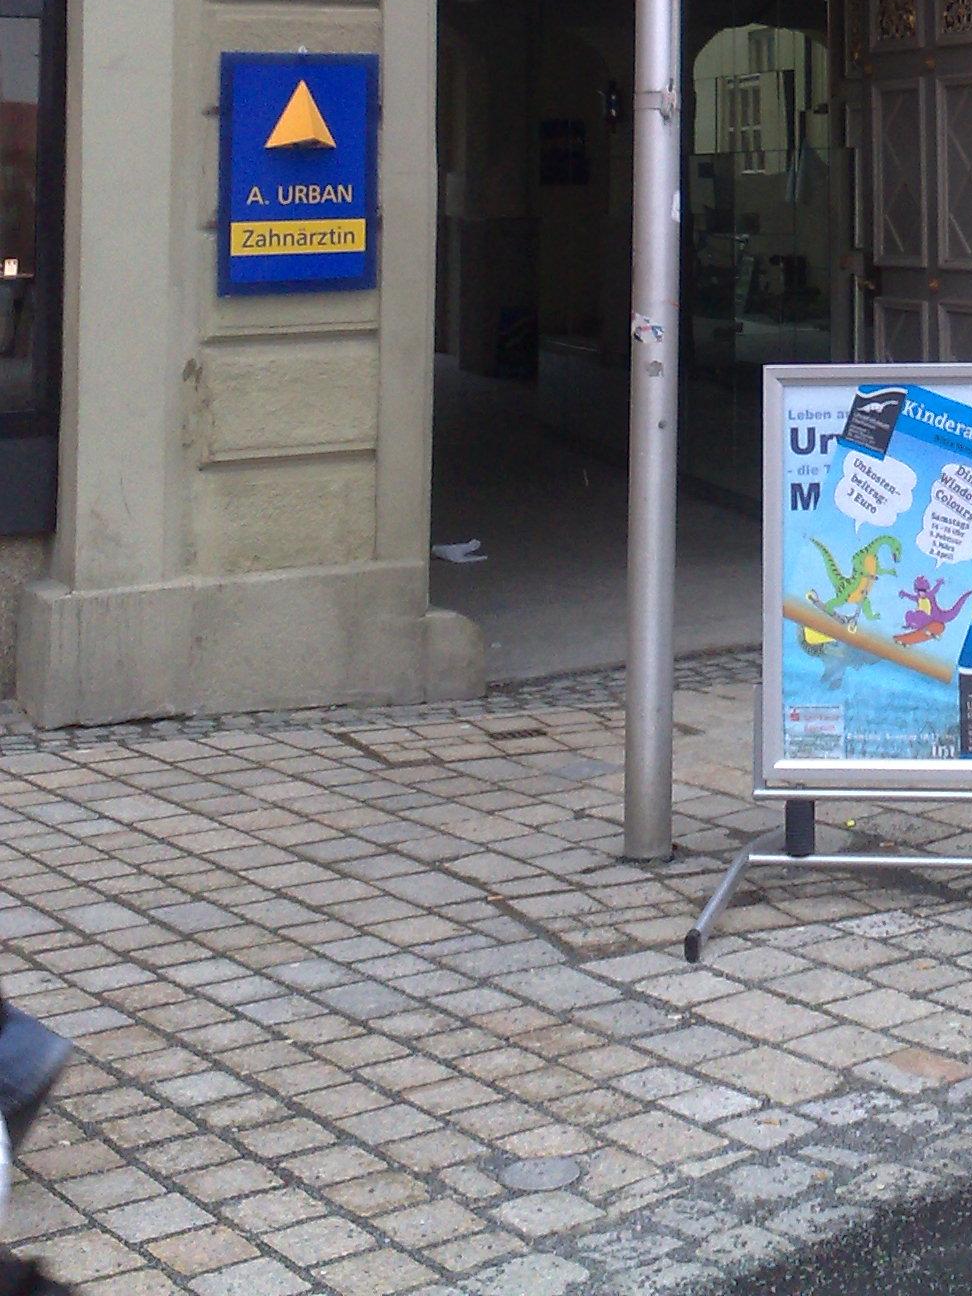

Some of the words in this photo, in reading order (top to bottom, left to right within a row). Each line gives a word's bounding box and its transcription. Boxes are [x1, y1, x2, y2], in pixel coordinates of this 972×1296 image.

[246, 186, 270, 205] A.
[277, 184, 353, 205] URBAN
[241, 225, 356, 249] Zahnärztin
[788, 409, 832, 421] Leben
[789, 426, 841, 456] Ur
[790, 482, 821, 512] M
[853, 492, 877, 514] Euro
